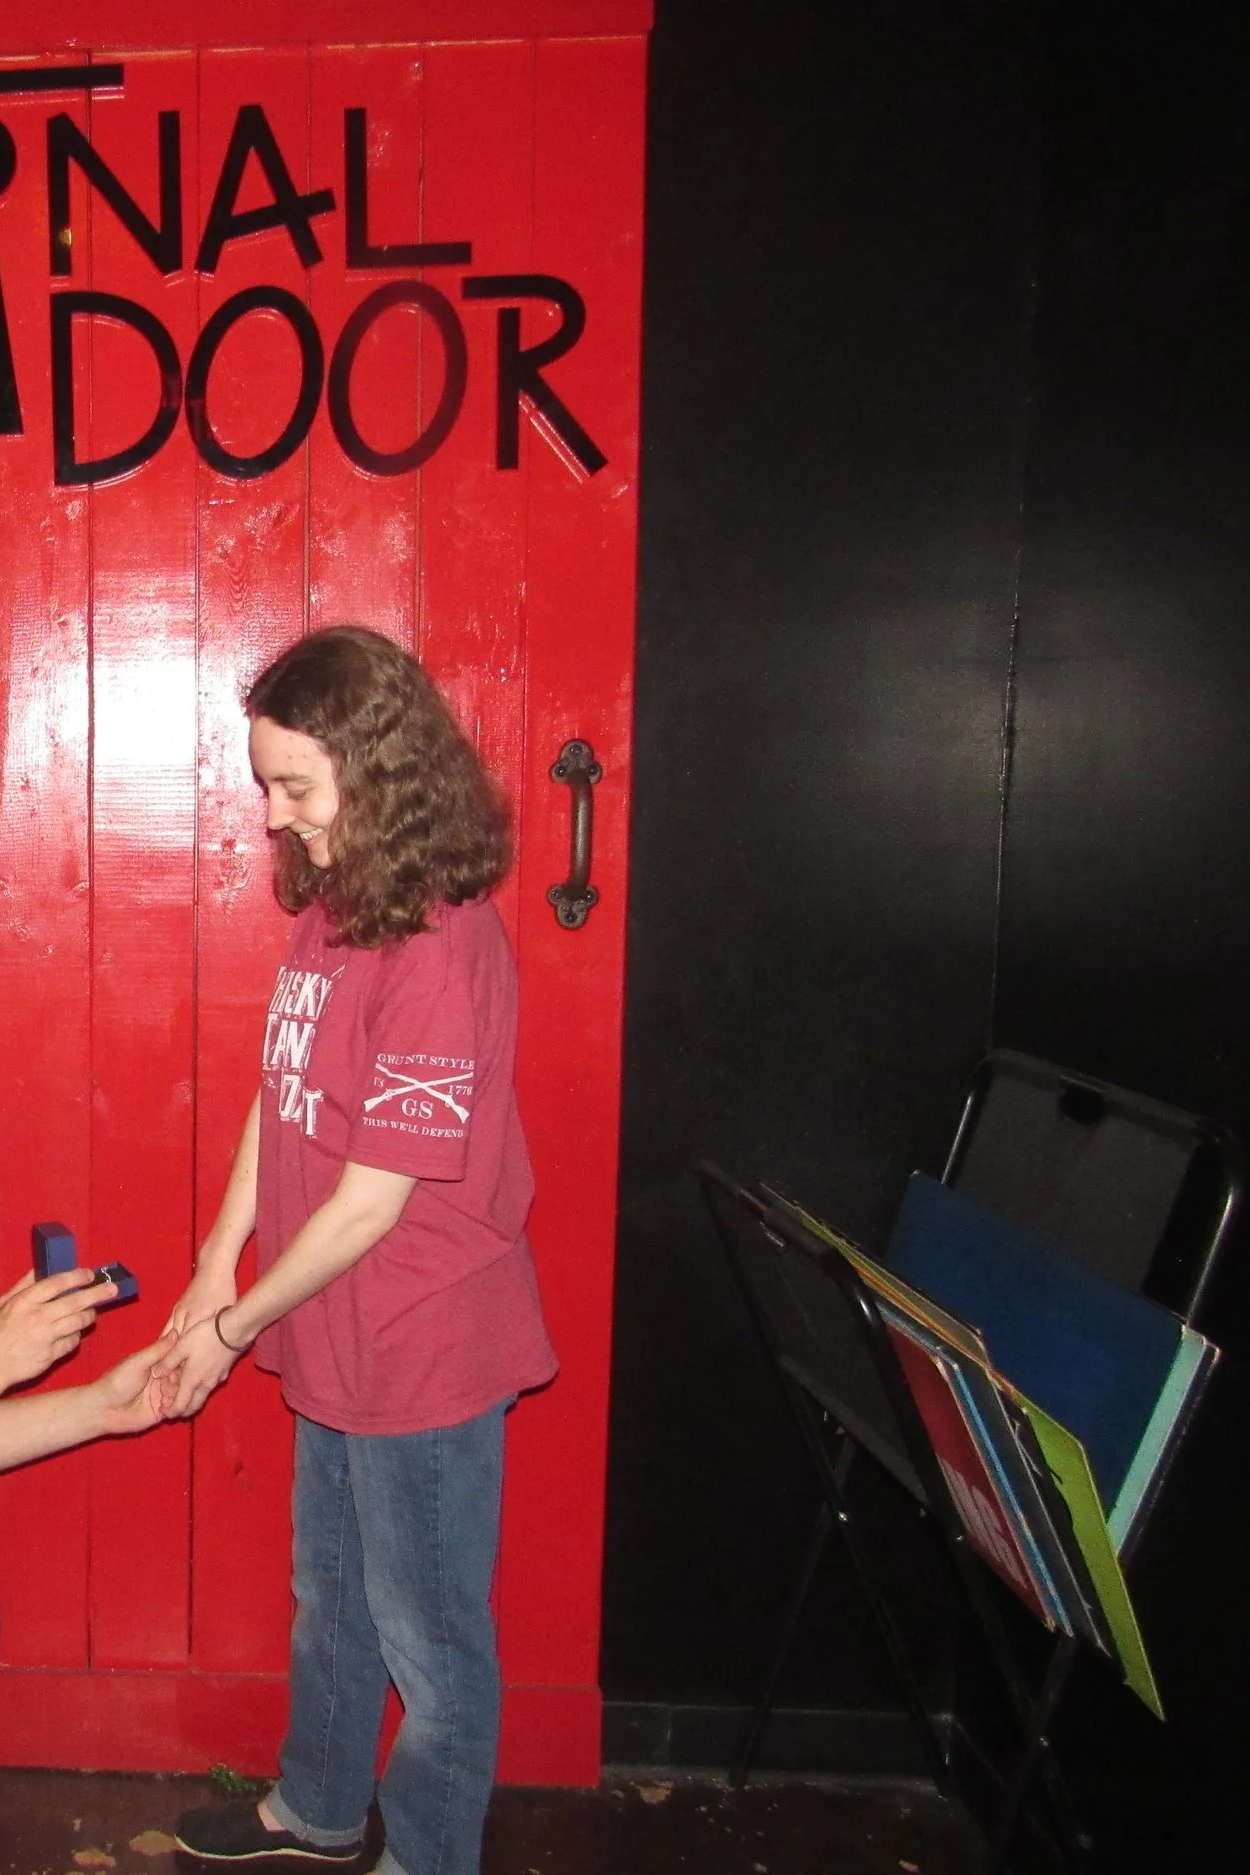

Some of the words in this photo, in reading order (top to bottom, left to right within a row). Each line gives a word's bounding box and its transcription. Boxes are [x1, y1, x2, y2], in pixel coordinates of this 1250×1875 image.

[50, 273, 609, 488] DOOR
[377, 1053, 426, 1065] GRUNT
[429, 1055, 475, 1070] STYLE
[448, 1085, 473, 1096] 1776
[401, 1098, 434, 1120] GS
[362, 1116, 388, 1128] THIS
[390, 1120, 419, 1134] WE'LL
[421, 1126, 464, 1138] DEFEND
